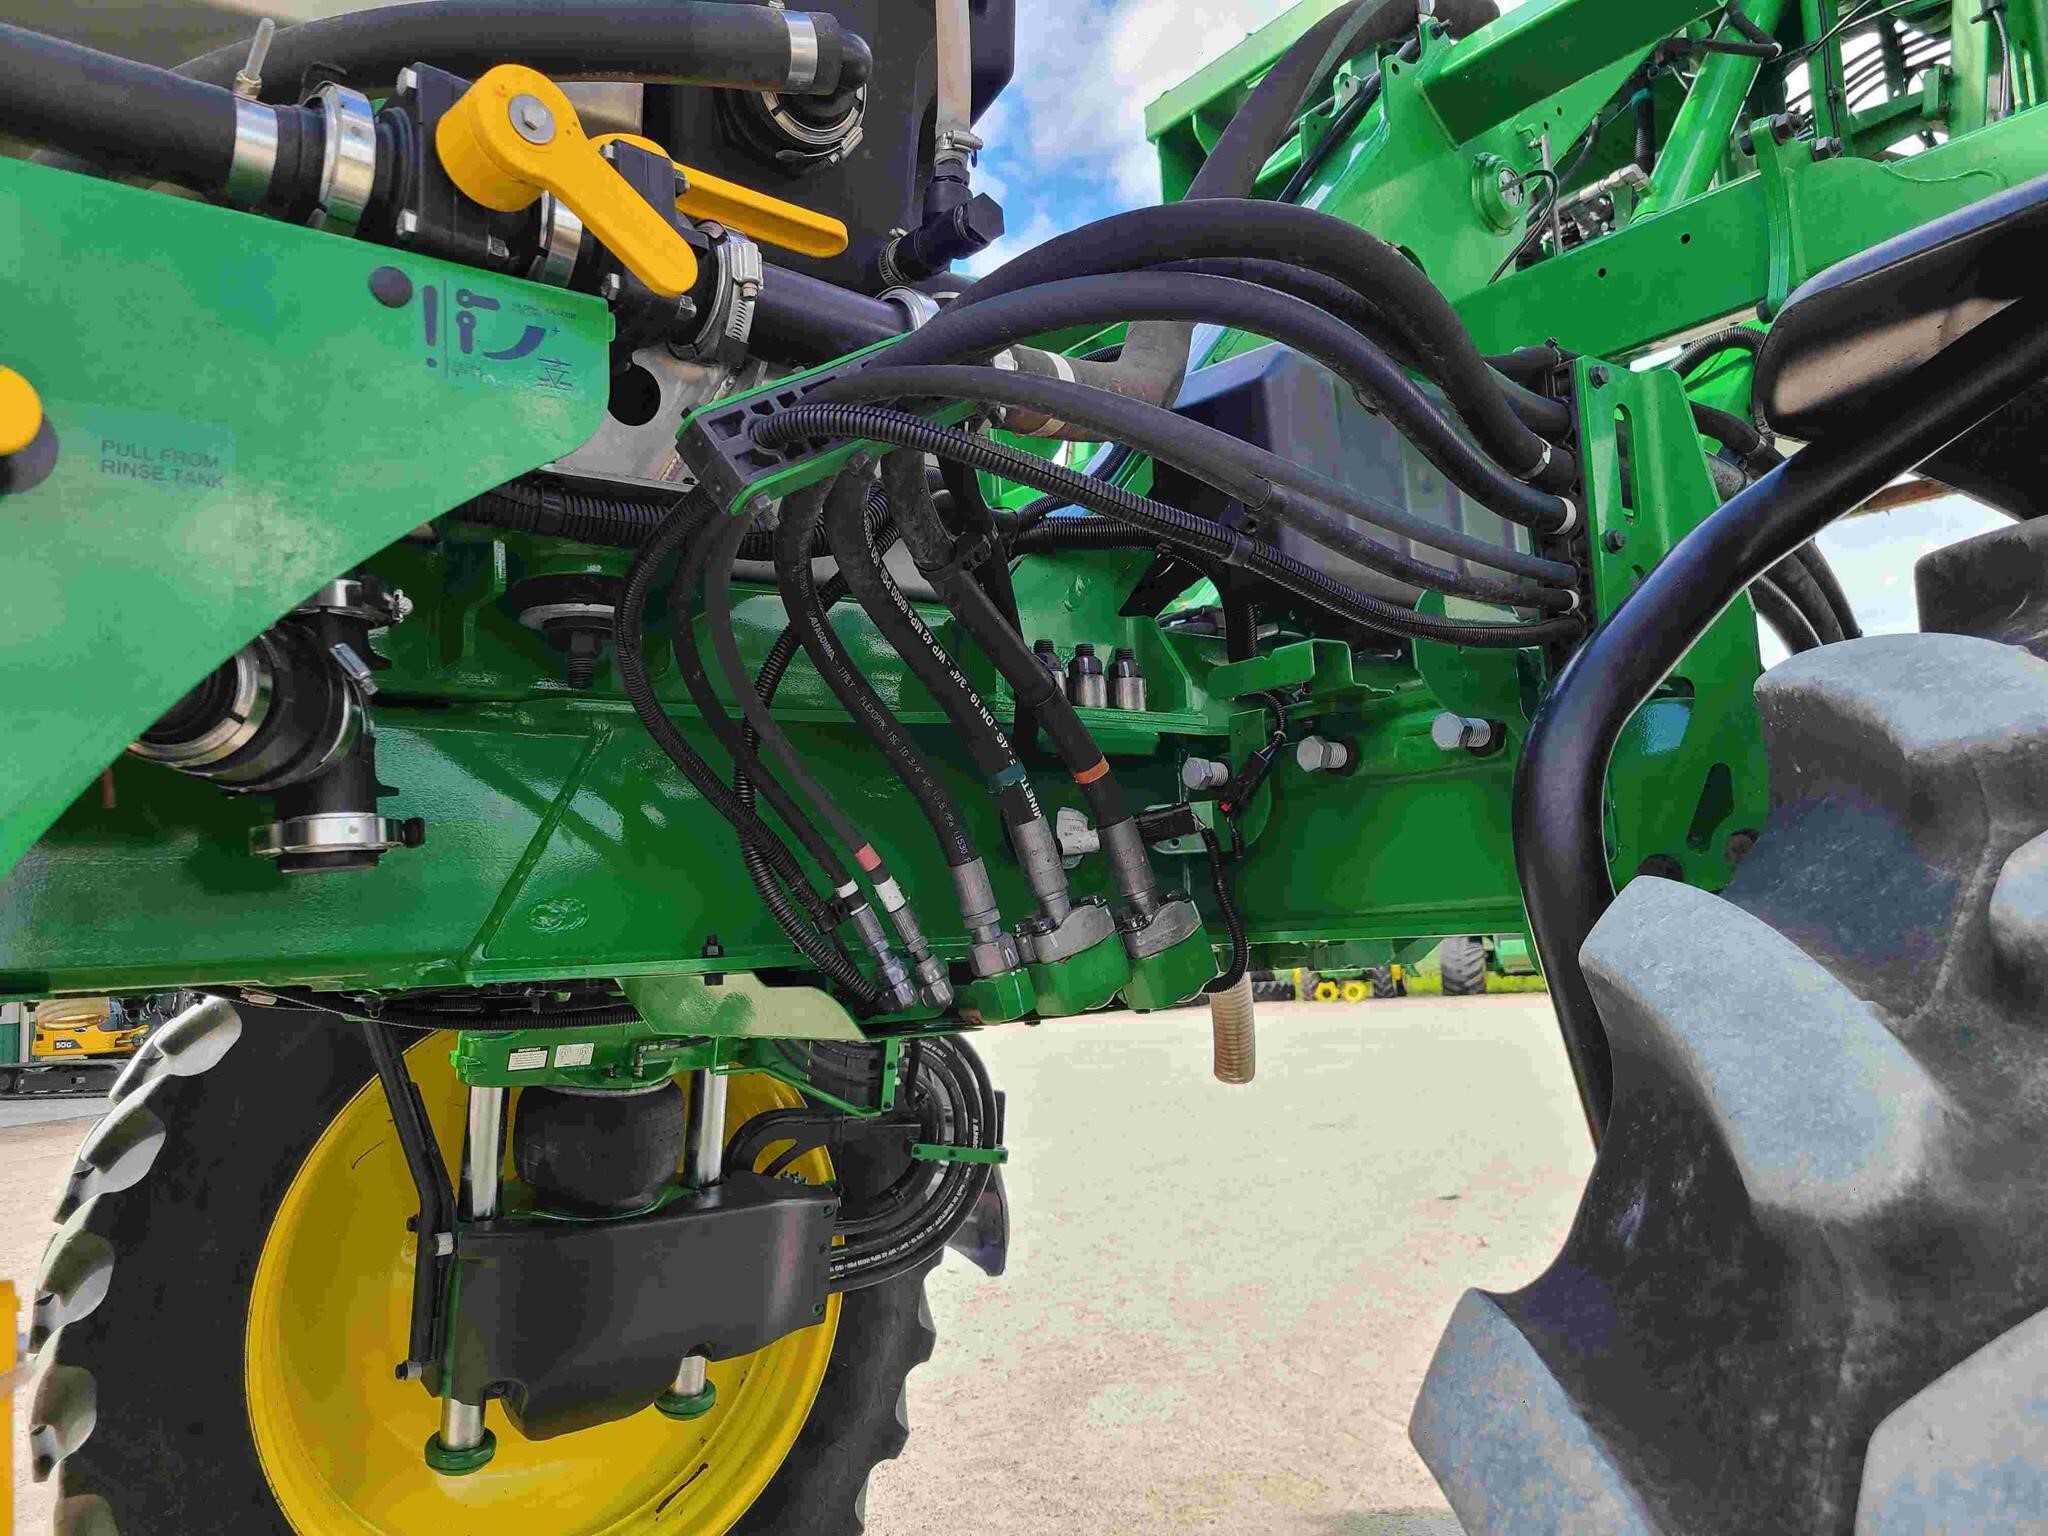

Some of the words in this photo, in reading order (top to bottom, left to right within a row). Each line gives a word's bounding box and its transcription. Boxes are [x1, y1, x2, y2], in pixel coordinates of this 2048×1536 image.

[102, 439, 154, 461] PULL
[160, 447, 219, 468] FROM
[101, 459, 168, 482] RINSE
[170, 468, 226, 489] TANK
[908, 610, 924, 634] MPa
[922, 631, 933, 645] 42
[932, 645, 946, 664] WP
[838, 666, 856, 687] ITALY
[950, 670, 967, 689] 3/4"
[970, 693, 980, 708] 19
[980, 706, 995, 727] DN
[996, 732, 1009, 748] 4S
